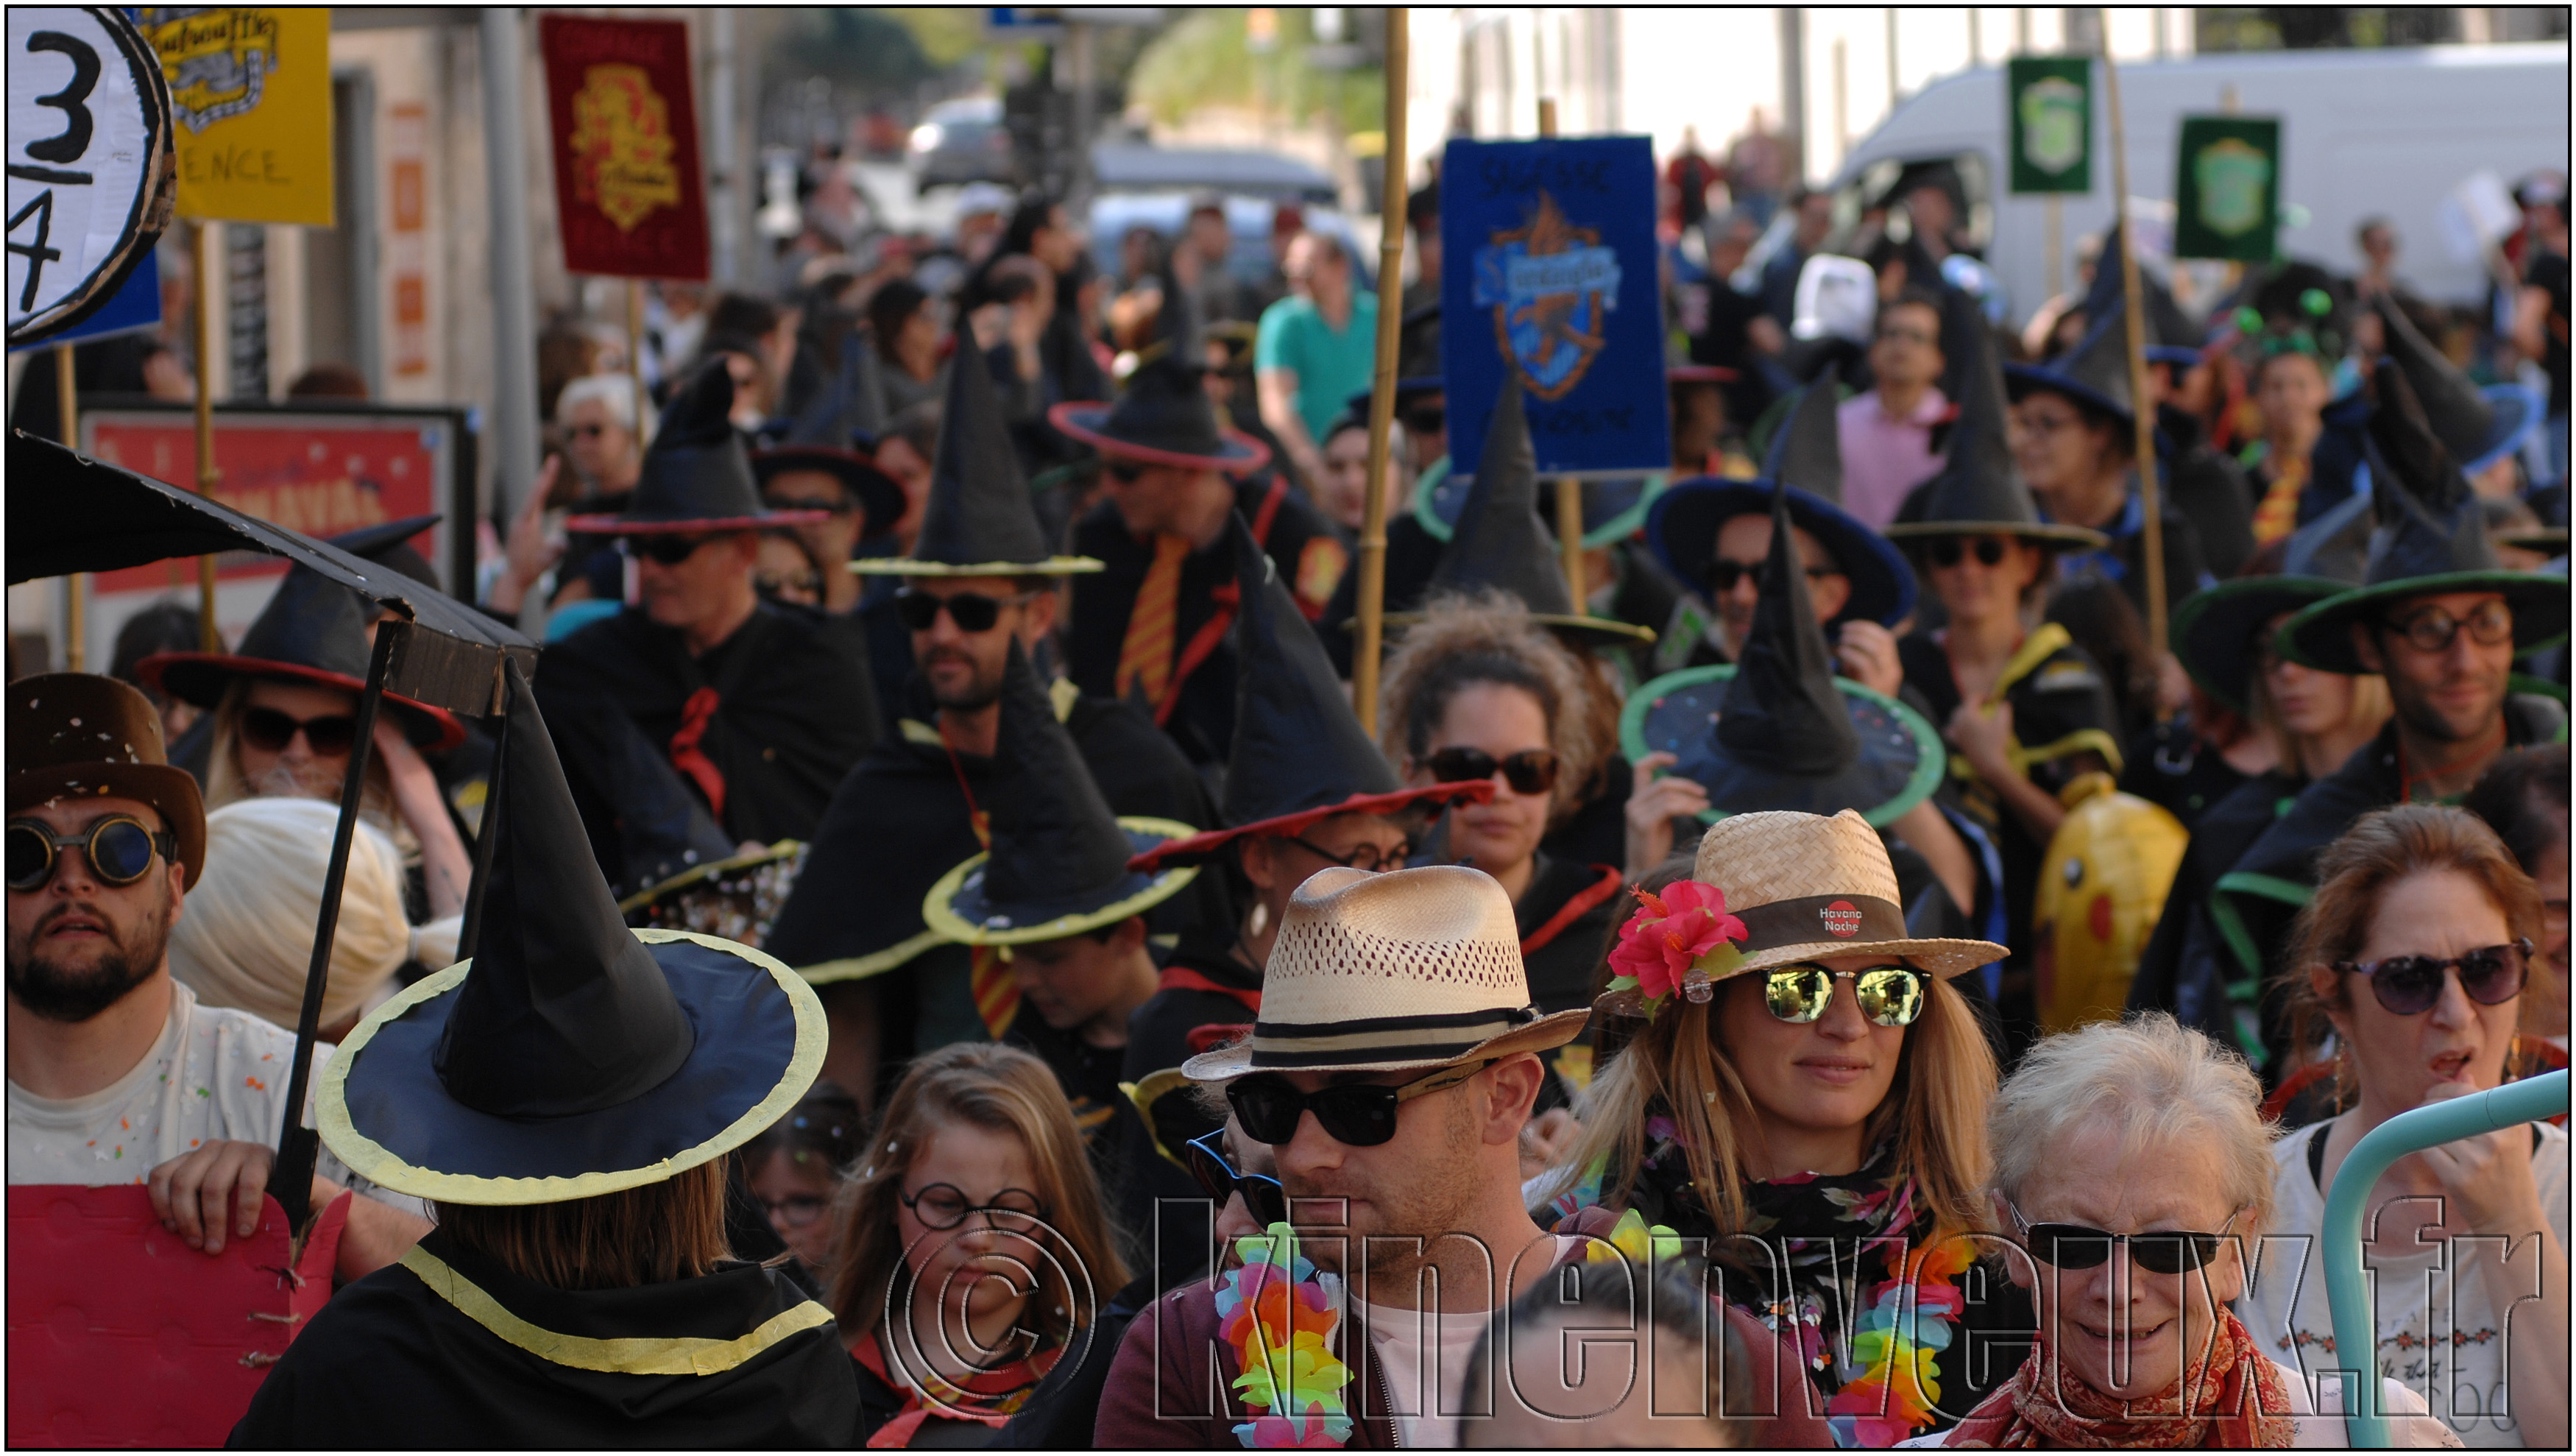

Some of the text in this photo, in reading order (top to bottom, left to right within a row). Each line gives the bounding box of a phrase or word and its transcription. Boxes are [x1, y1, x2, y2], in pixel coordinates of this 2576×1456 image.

[24, 31, 102, 163] 3
[8, 188, 61, 313] 4
[1819, 908, 1862, 919] Havana
[1825, 920, 1859, 932] Noche
